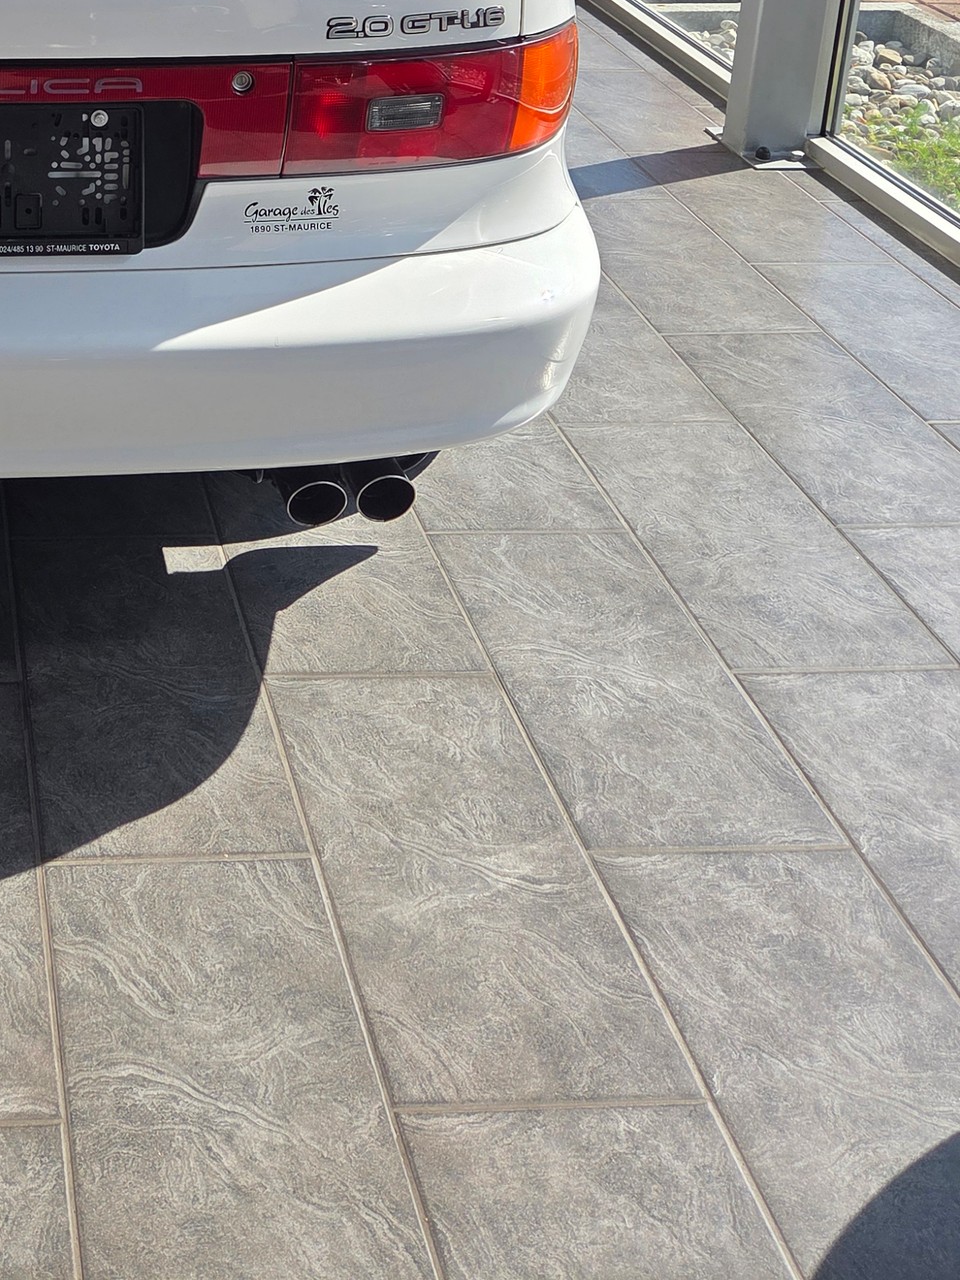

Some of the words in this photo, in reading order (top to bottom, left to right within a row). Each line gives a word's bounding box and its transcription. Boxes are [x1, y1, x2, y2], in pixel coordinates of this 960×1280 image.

[326, 14, 394, 40] 2.0
[244, 201, 298, 223] Garage
[300, 206, 315, 216] des
[250, 224, 271, 233] 1890
[273, 221, 332, 232] ST-MAURICE
[0, 245, 25, 254] 024/485
[26, 244, 34, 253] 13
[35, 244, 44, 253] 90
[46, 244, 87, 253] ST-MAURICE
[88, 243, 120, 251] TOYOTA
